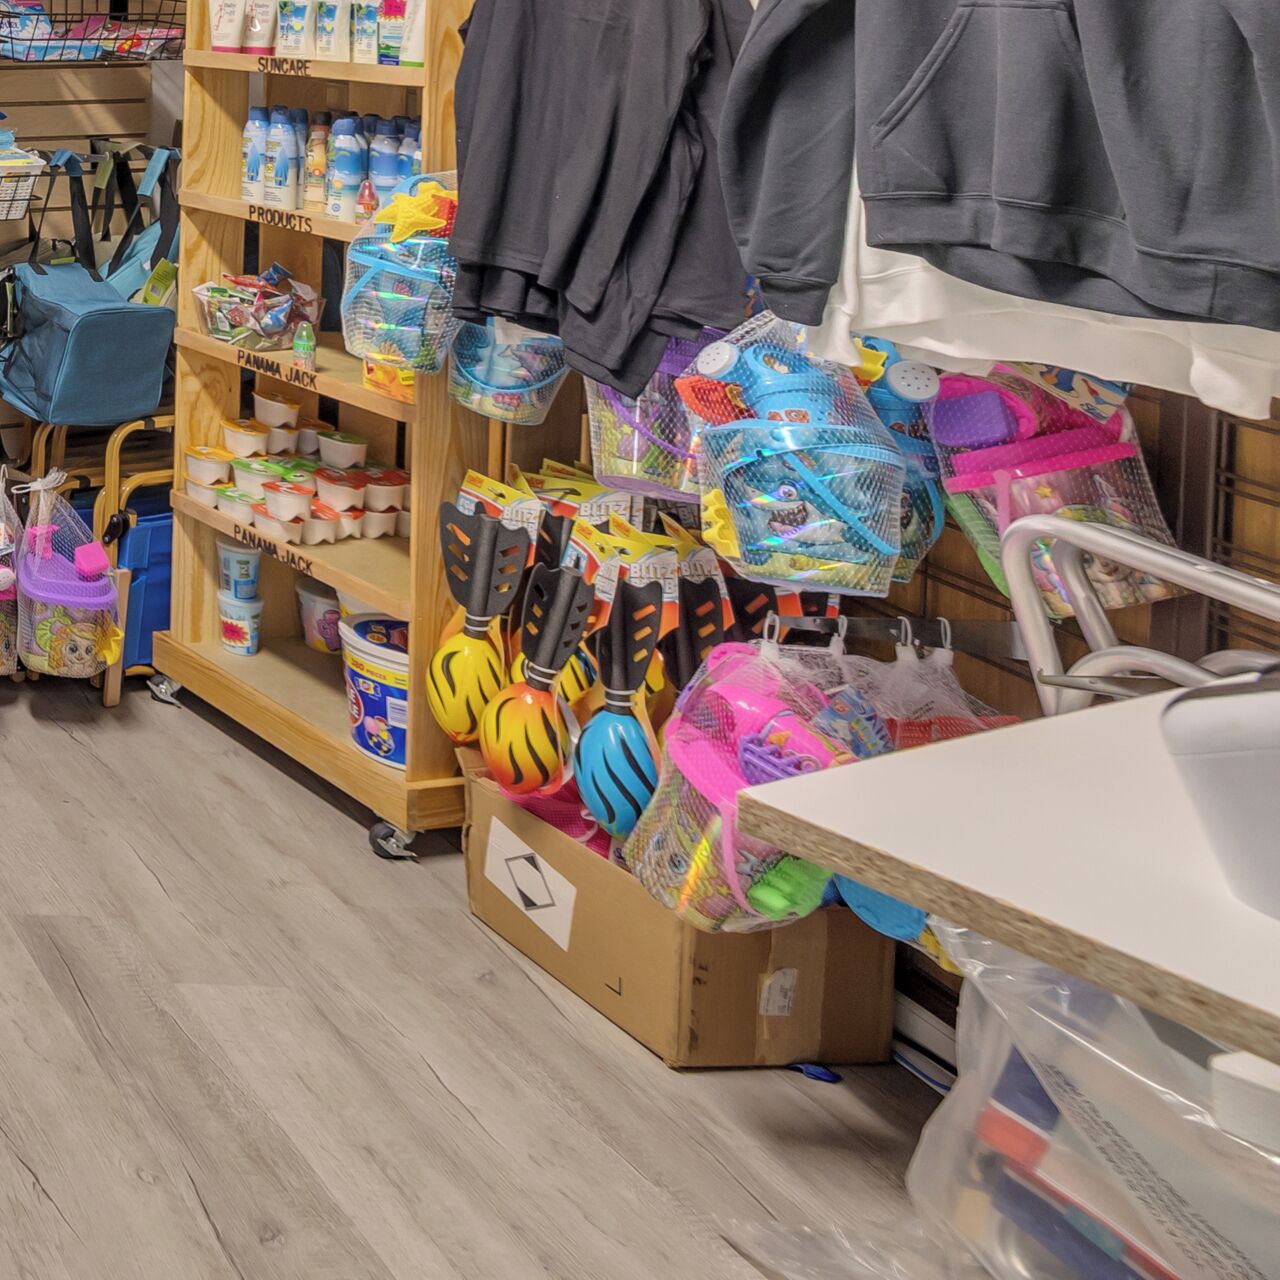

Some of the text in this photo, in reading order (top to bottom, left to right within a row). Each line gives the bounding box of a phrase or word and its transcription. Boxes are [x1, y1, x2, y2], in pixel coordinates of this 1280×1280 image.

[257, 56, 312, 76] SUNCARE
[249, 205, 313, 234] PRODUCTS
[237, 349, 318, 389] PANAMA JACK
[580, 503, 627, 517] BLITZ
[234, 524, 313, 576] PANAMA JACK
[630, 563, 675, 576] BLITZ
